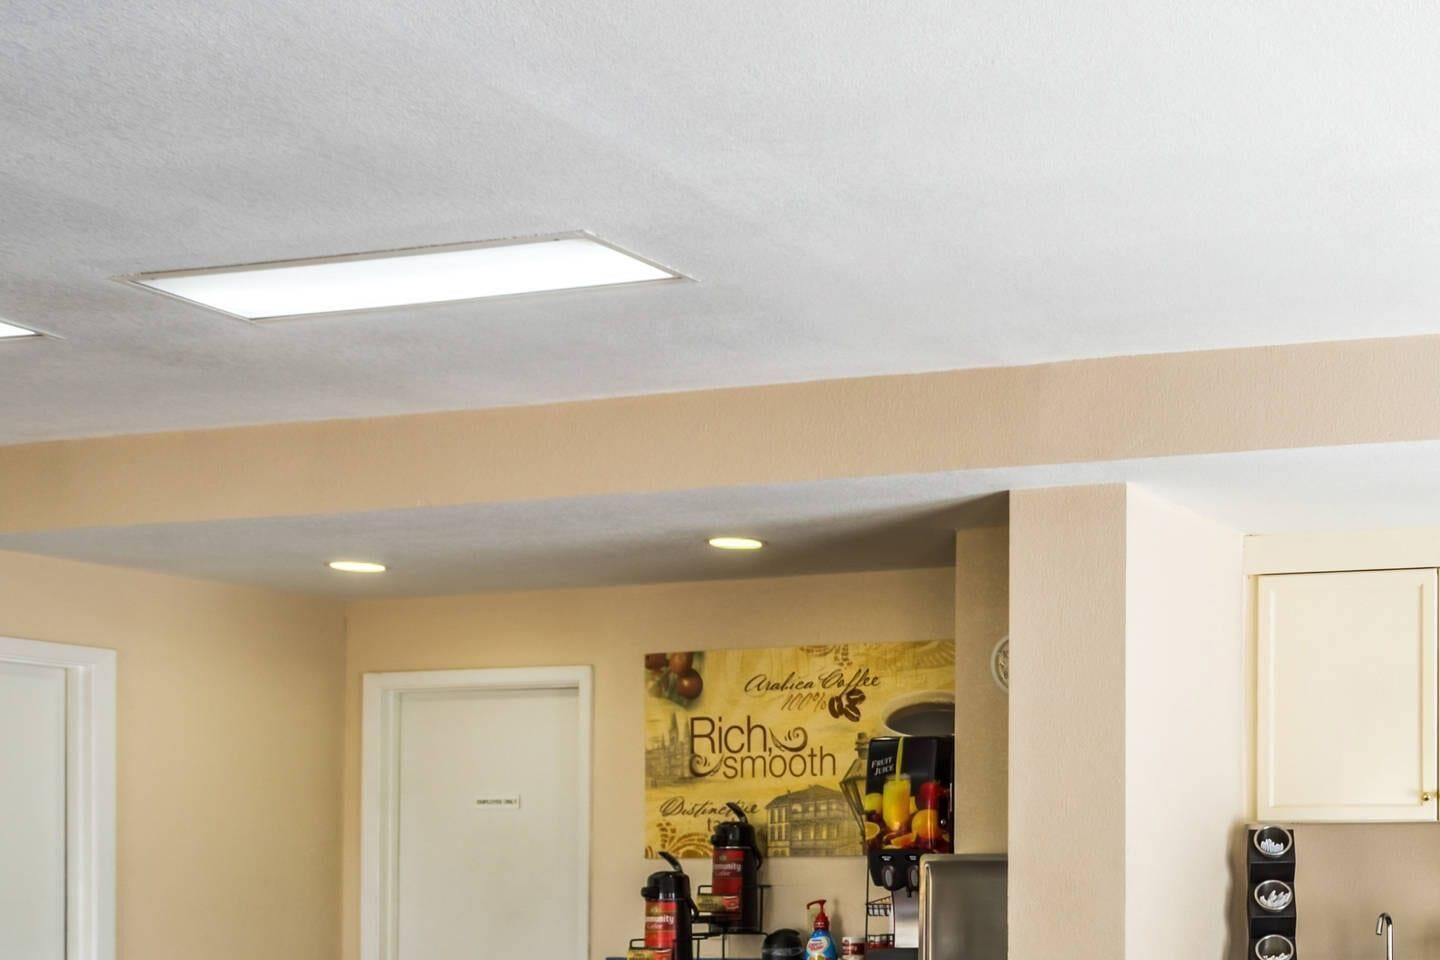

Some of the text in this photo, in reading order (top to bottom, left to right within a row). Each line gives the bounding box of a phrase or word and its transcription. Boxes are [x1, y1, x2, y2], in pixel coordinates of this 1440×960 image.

[744, 667, 881, 695] Arabica Coffee
[723, 745, 837, 779] smooth
